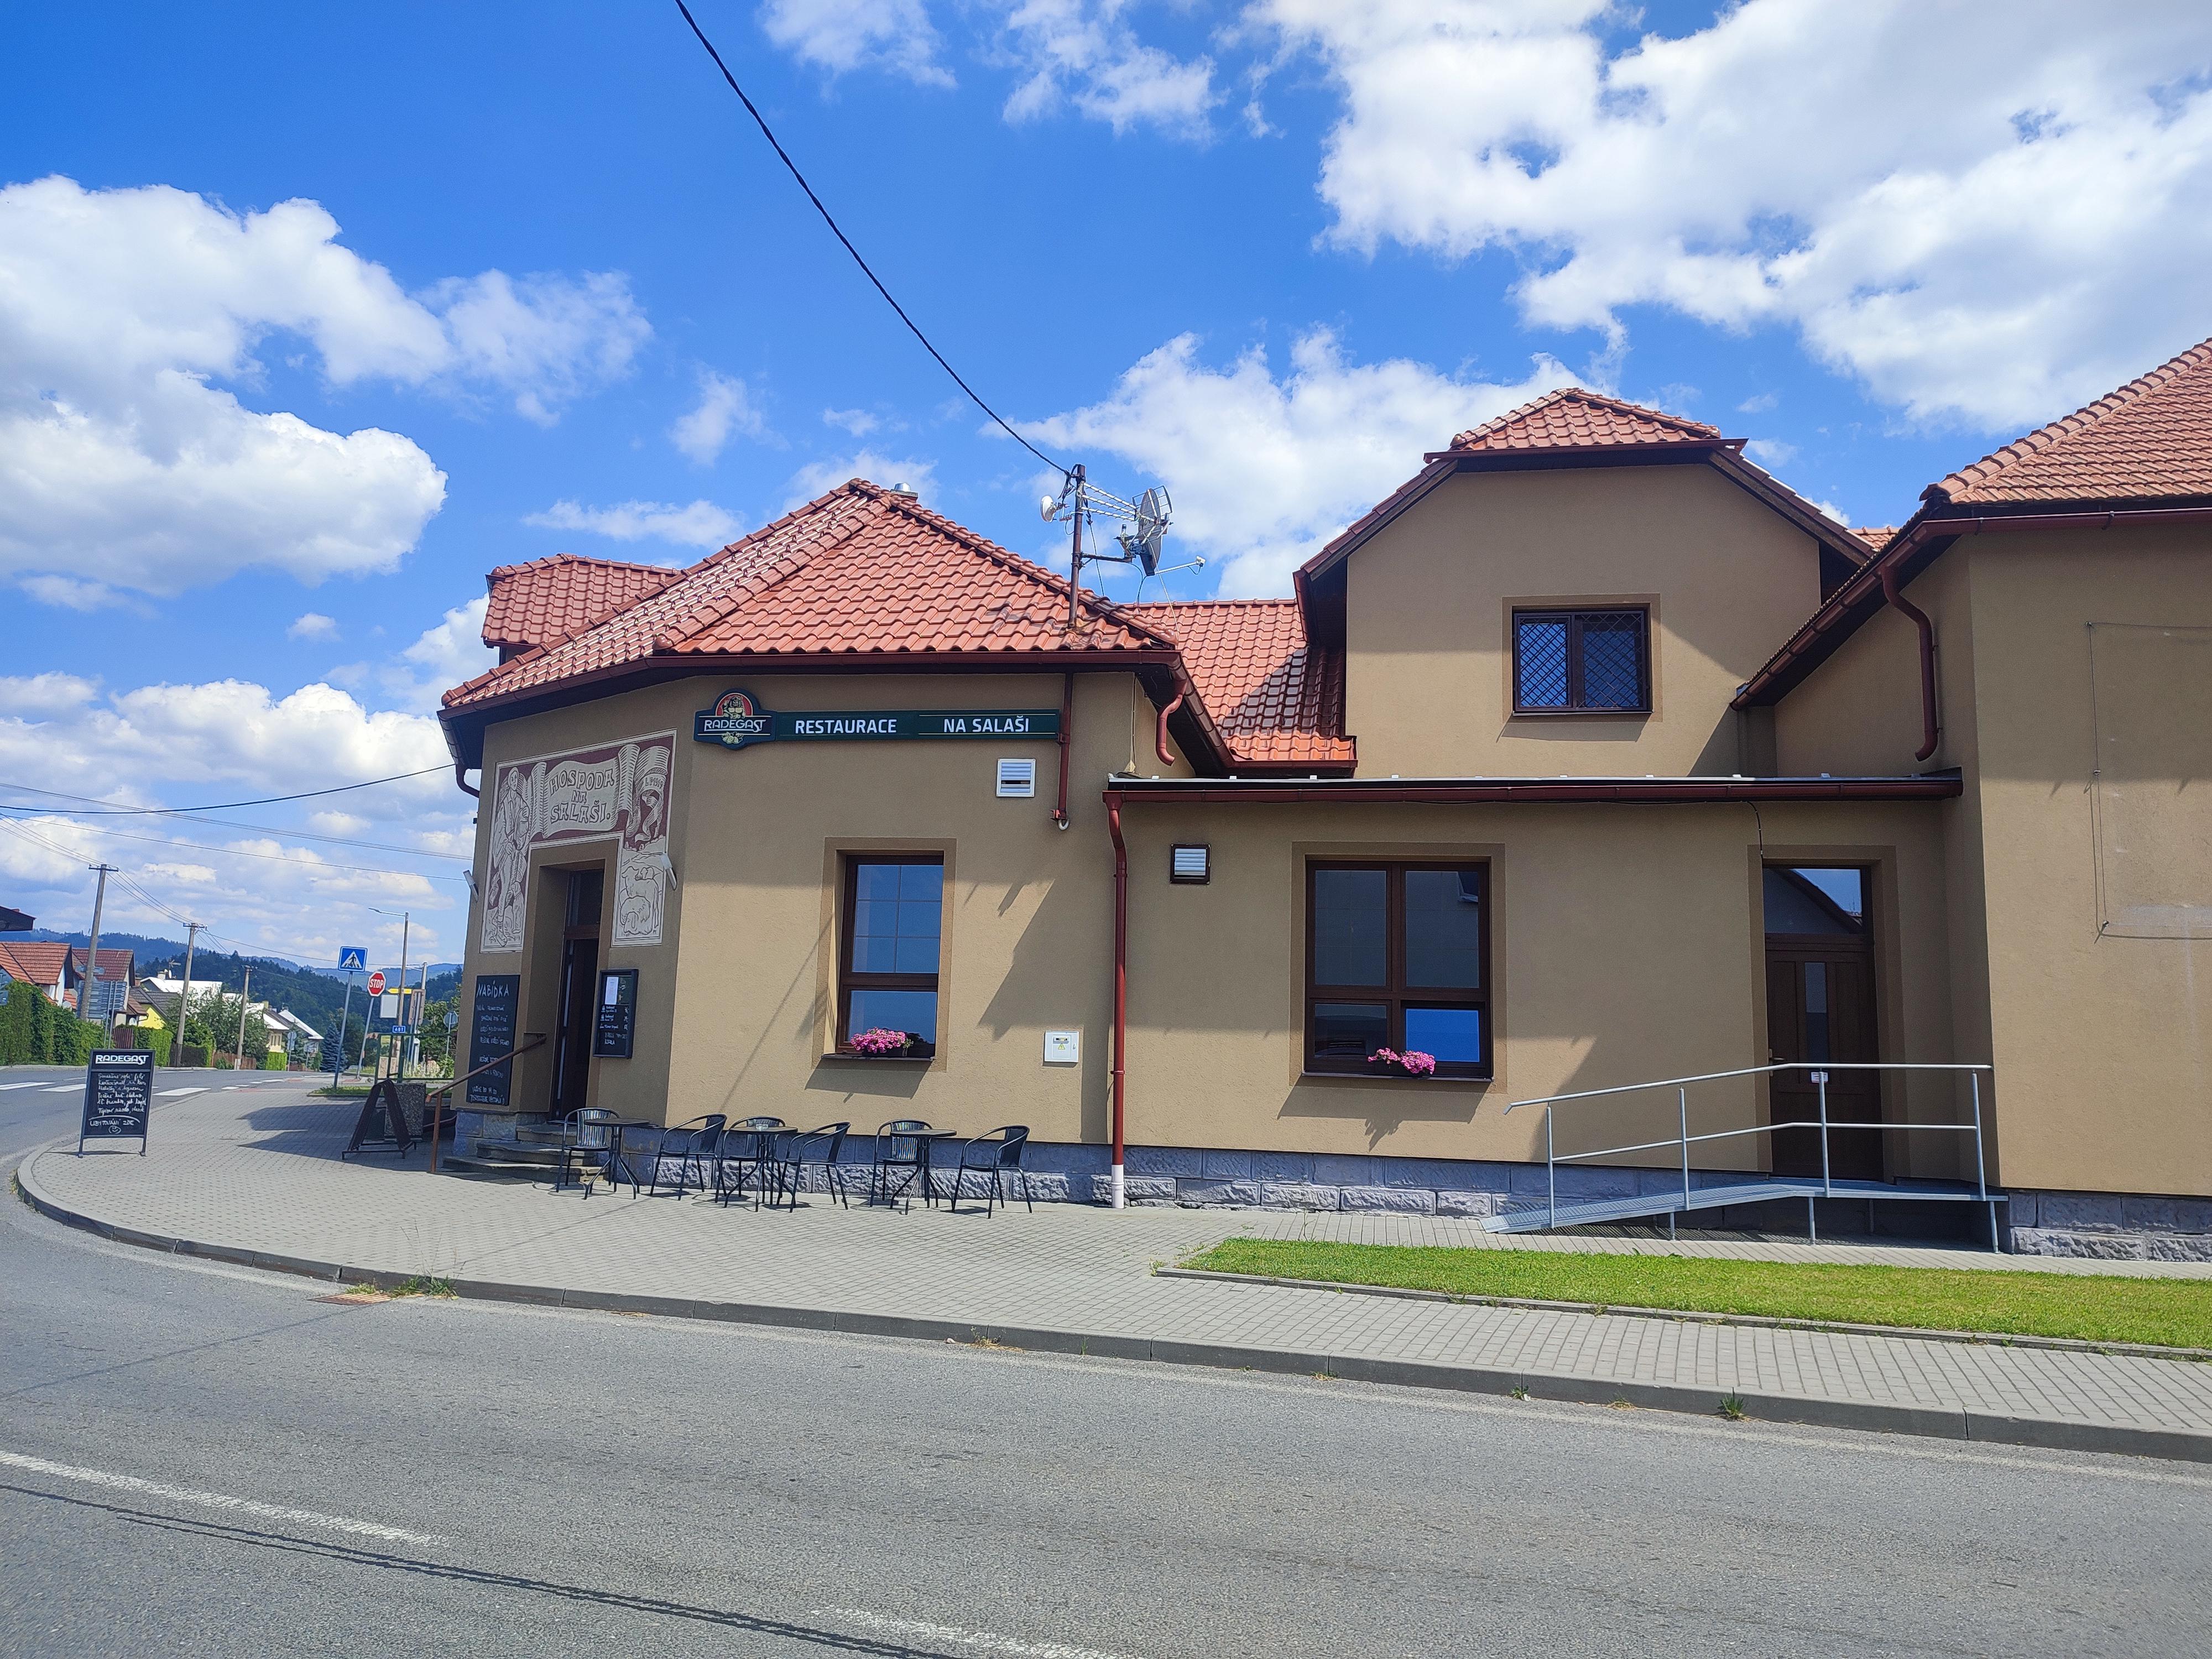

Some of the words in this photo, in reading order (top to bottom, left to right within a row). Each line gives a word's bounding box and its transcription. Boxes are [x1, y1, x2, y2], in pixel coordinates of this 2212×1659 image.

[704, 719, 766, 733] RADEGAST
[795, 719, 897, 734] RESTAURACE
[943, 718, 966, 733] NA
[972, 715, 1029, 732] SALAŠI
[549, 768, 615, 796] HOSPODA
[571, 790, 587, 804] NA
[550, 800, 611, 824] SALAŠI.
[369, 978, 384, 989] STOP
[476, 980, 509, 998] NABÍDKA
[95, 1055, 149, 1065] RADEGAST
